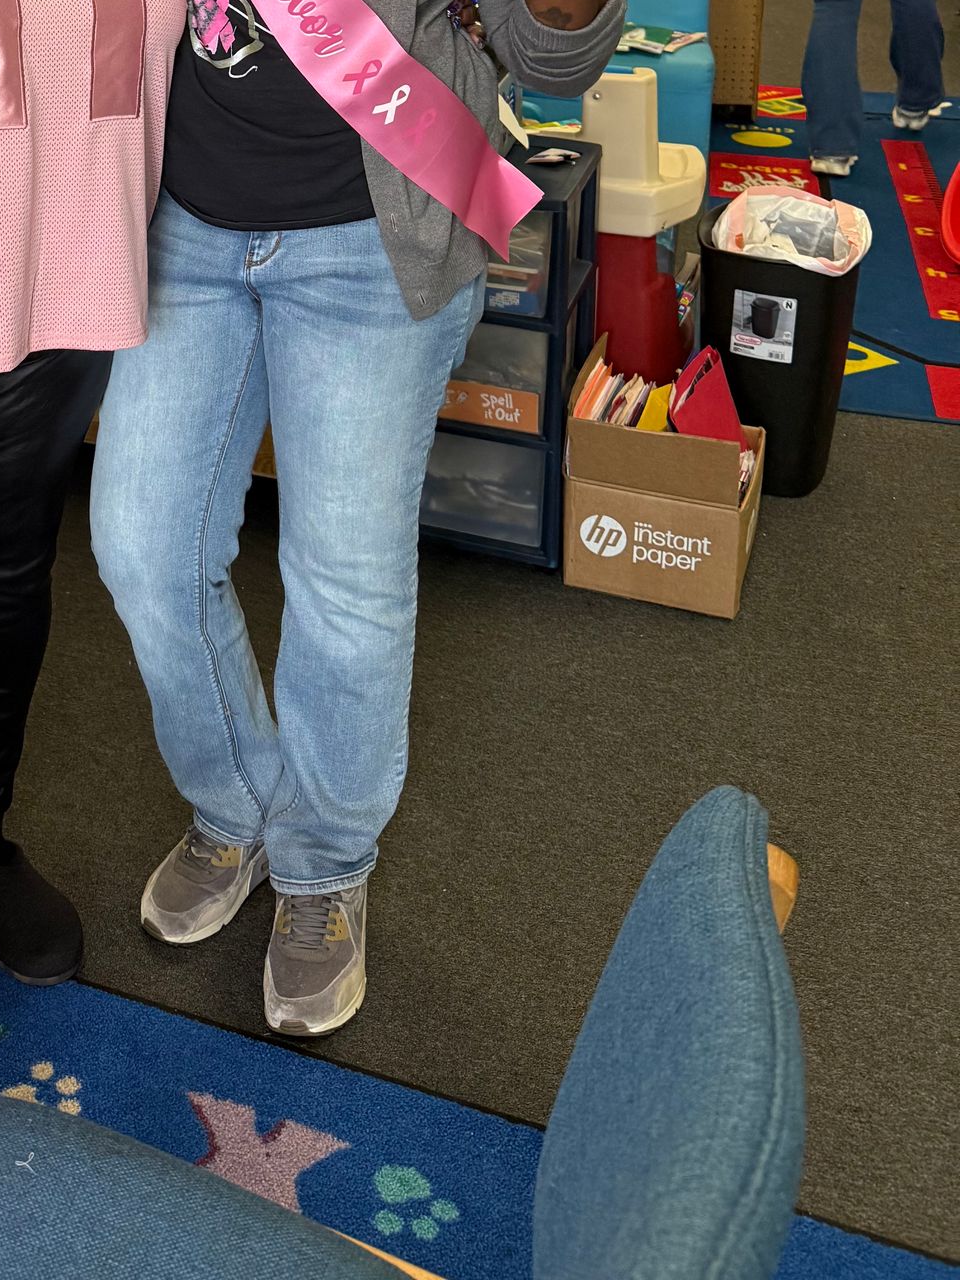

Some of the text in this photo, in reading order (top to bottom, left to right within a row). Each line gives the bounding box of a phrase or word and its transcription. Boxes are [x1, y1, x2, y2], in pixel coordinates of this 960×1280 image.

[720, 162, 802, 174] zebra
[938, 309, 960, 321] 5
[480, 393, 513, 410] Spell
[484, 408, 521, 424] it Out
[582, 514, 712, 557] hp instant
[632, 544, 702, 571] paper
